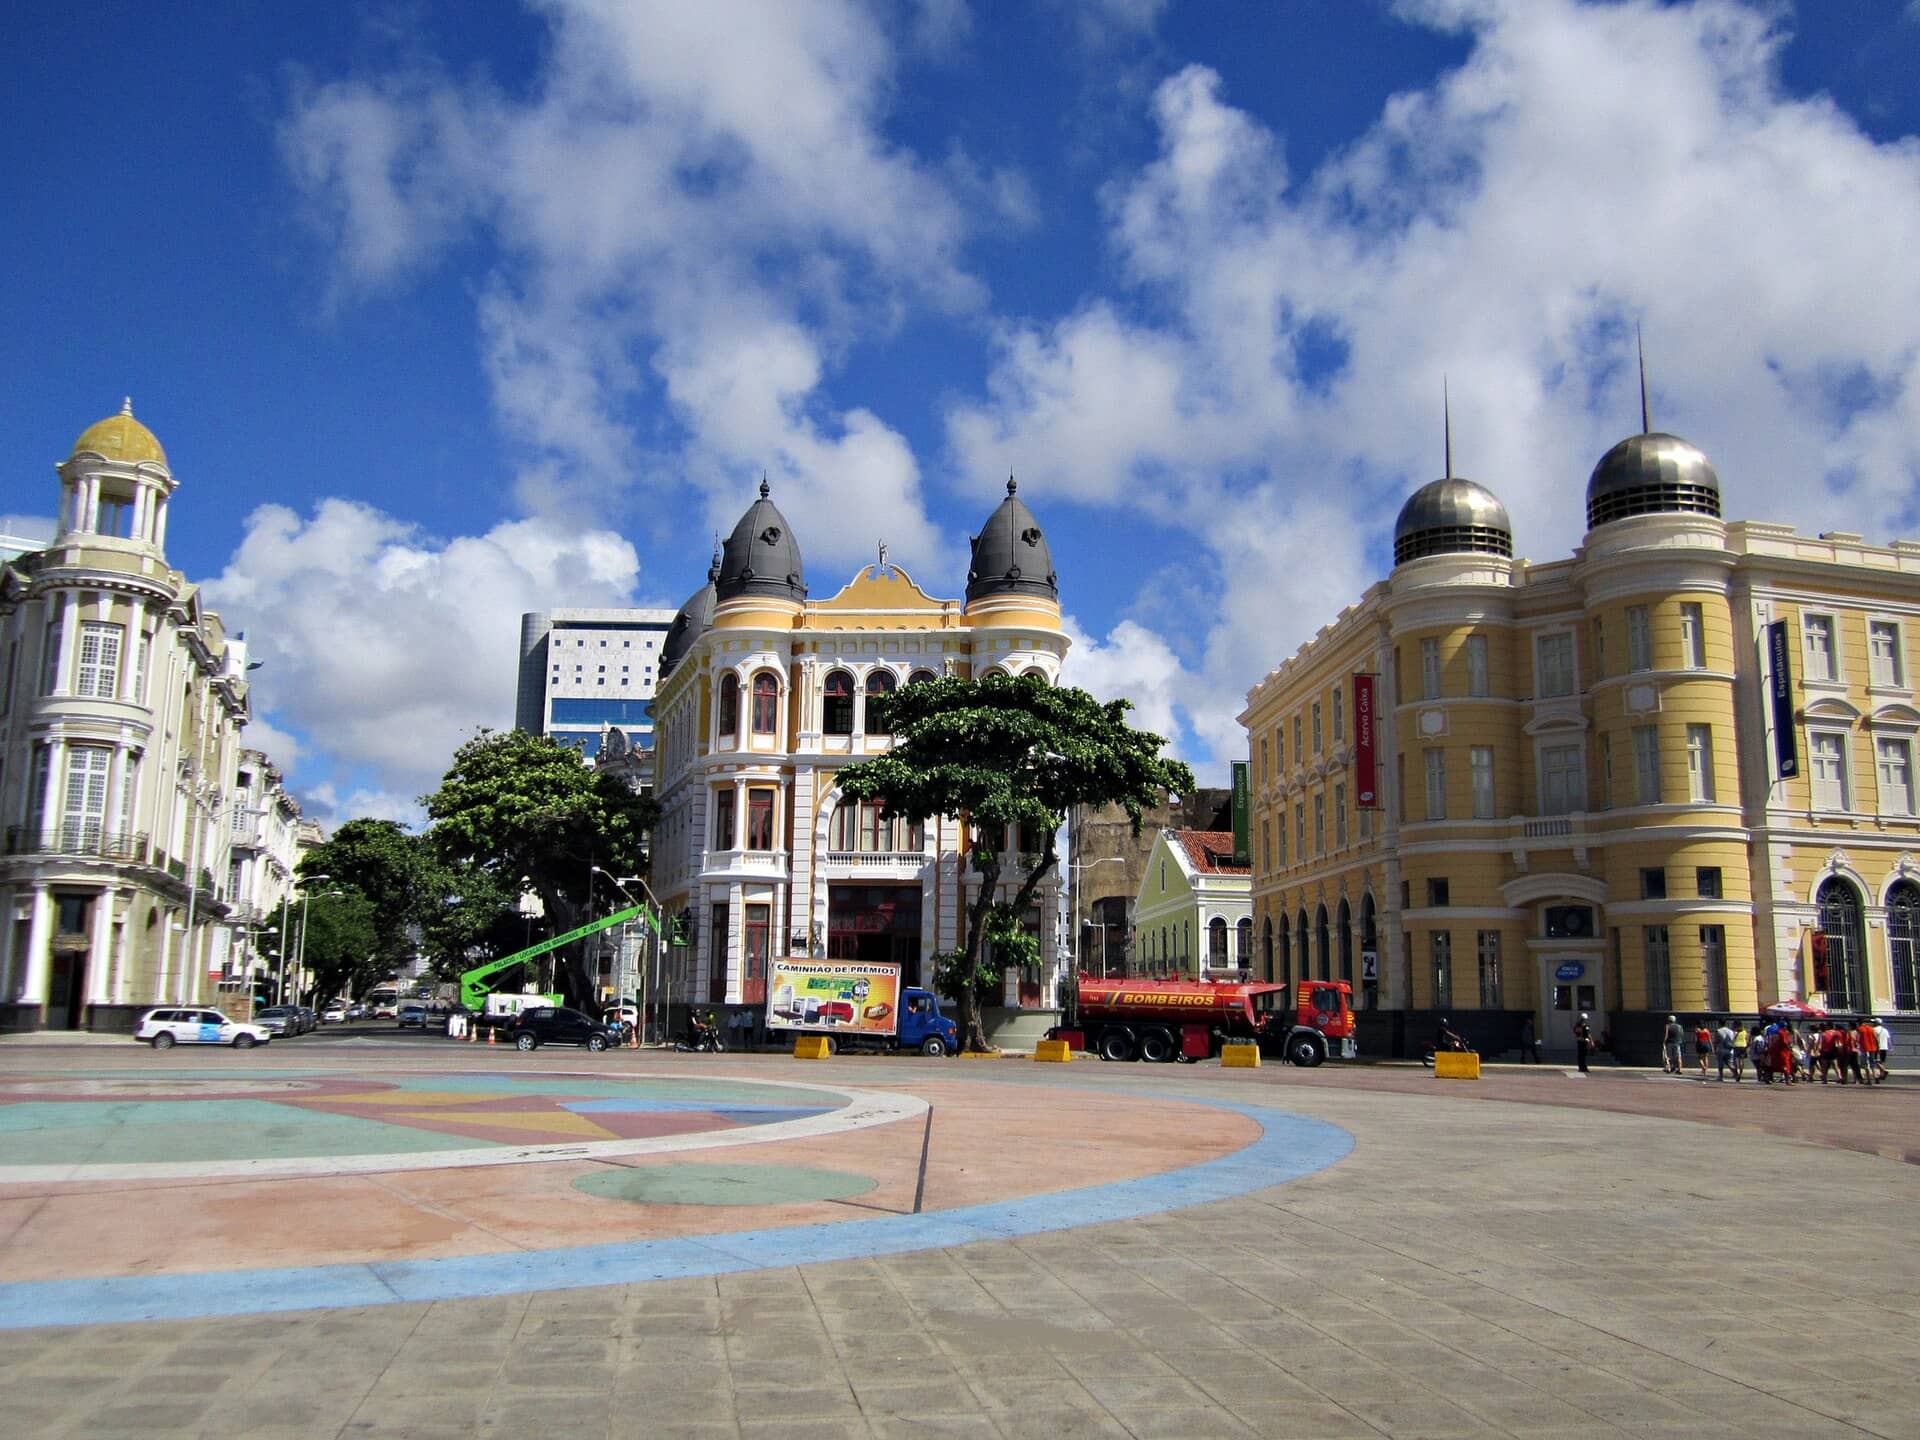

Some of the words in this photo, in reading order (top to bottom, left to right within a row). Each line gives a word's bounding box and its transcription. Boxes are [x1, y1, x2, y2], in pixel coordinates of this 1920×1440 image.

[1775, 633, 1785, 698] Espetáculos
[1360, 688, 1369, 713] Caixa
[1361, 715, 1370, 747] Acervo
[1123, 994, 1215, 1006] BOMBEIROS
